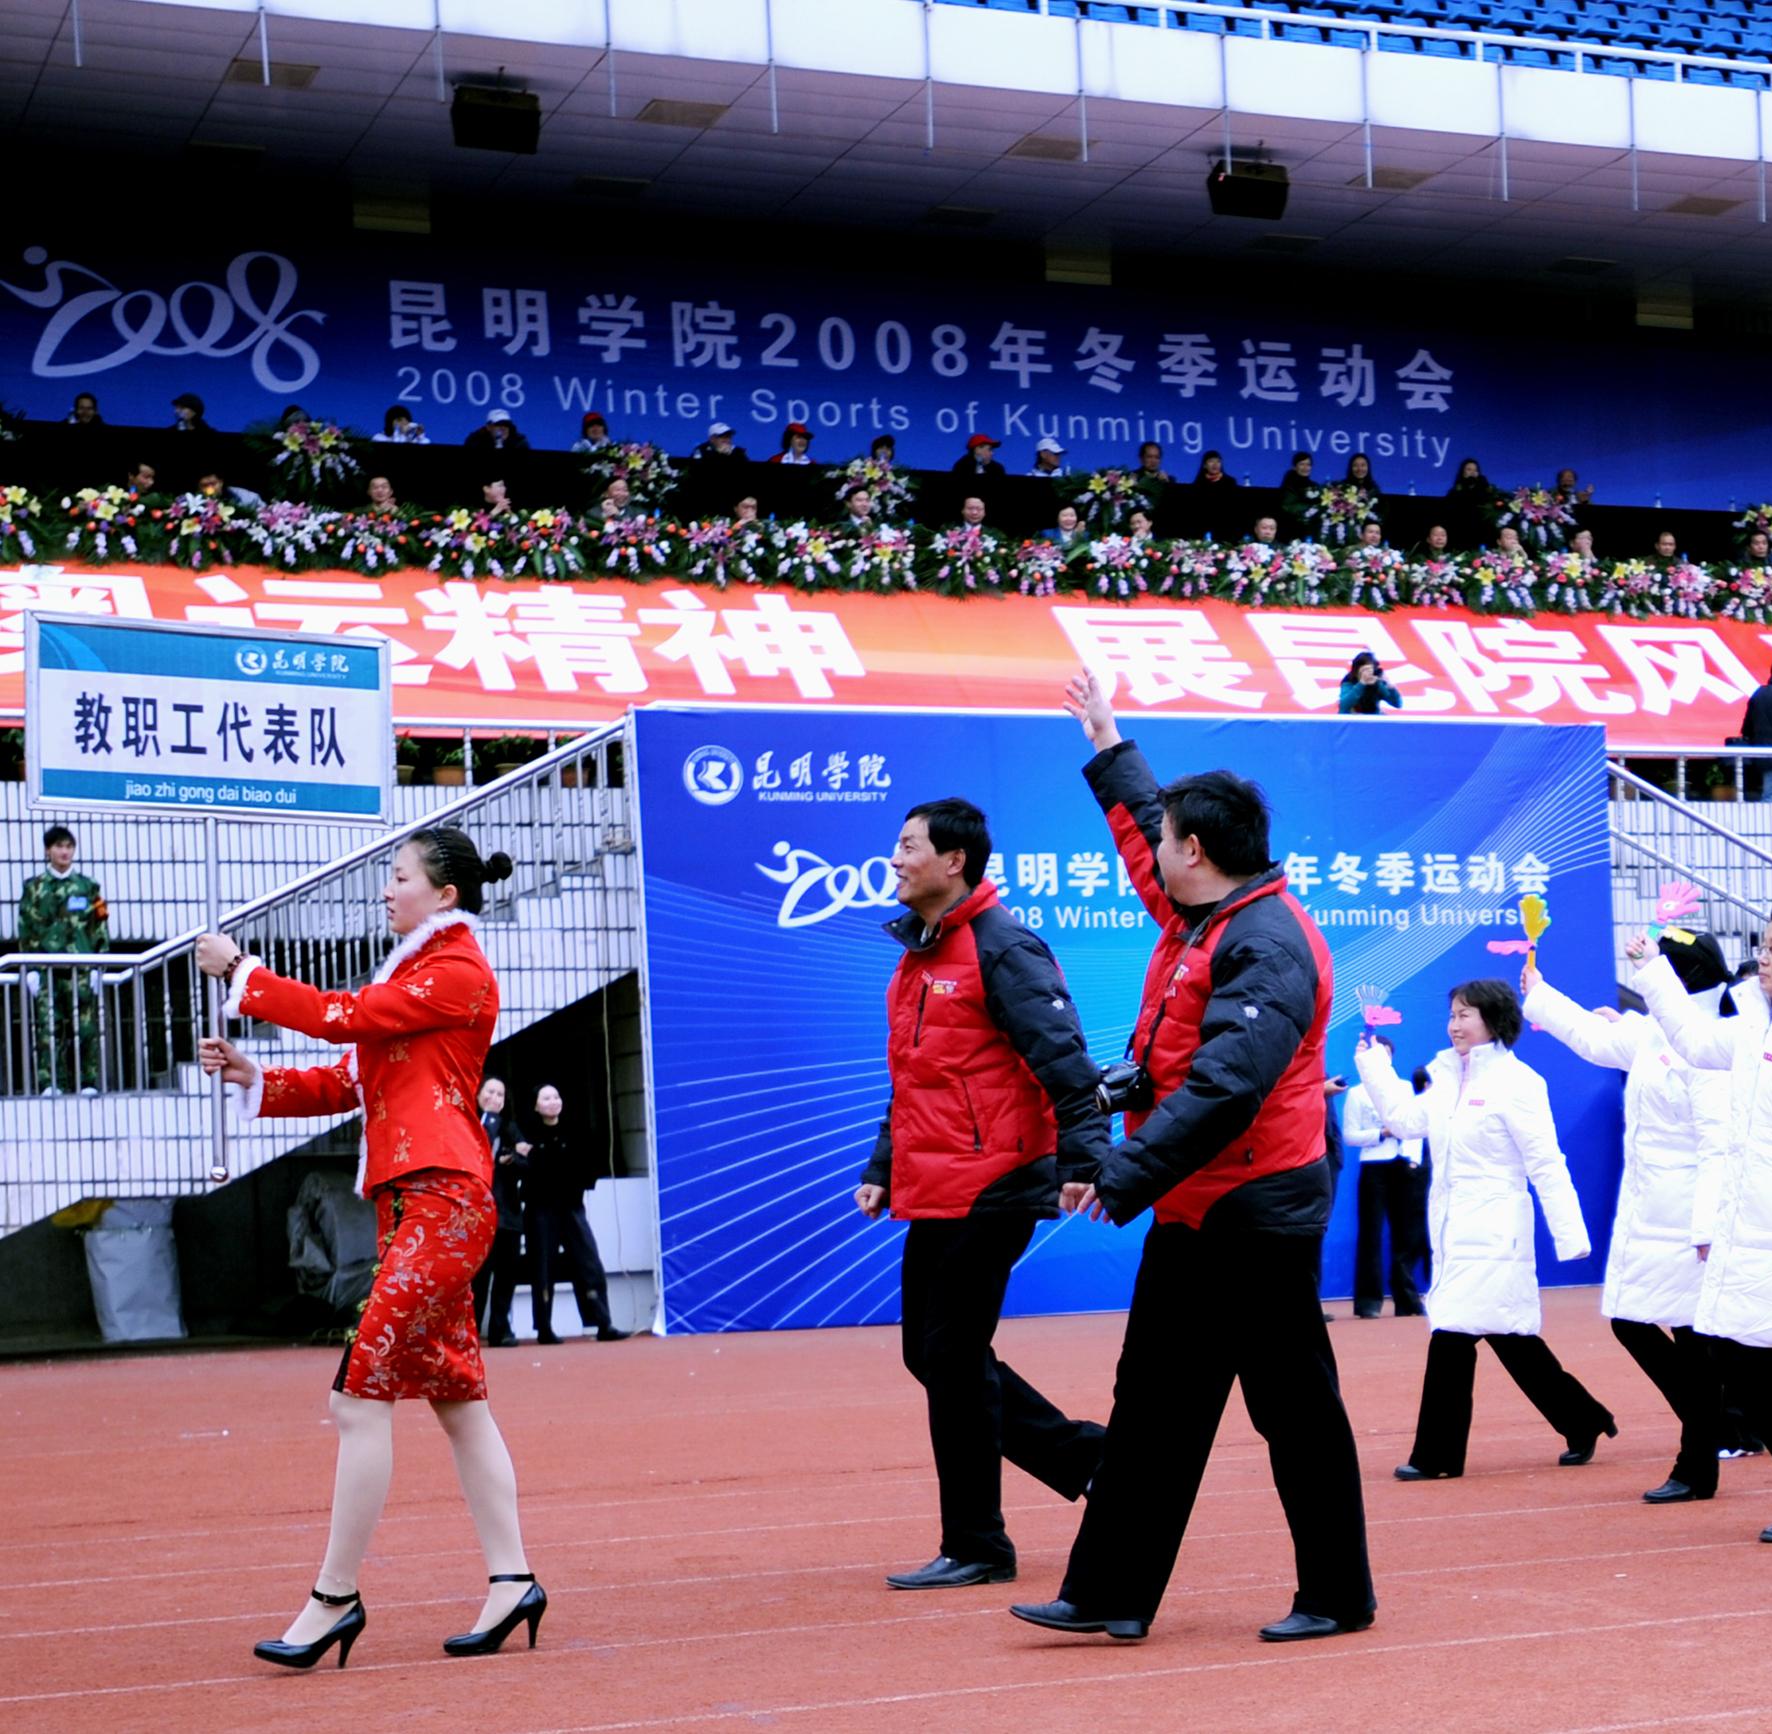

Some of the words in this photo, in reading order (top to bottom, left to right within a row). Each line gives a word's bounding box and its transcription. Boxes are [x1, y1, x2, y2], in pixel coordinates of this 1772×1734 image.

[389, 280, 1454, 413] 昆明学院2008年冬季运动会
[396, 366, 526, 408] 2008
[553, 375, 724, 420] Winter
[751, 388, 911, 431] Sports
[936, 401, 979, 433] of
[1003, 402, 1203, 454] Kunming
[1228, 416, 1451, 468] University
[74, 691, 346, 768] 教职工代表队
[125, 780, 151, 799] jiao
[154, 782, 176, 797] zhi
[178, 786, 214, 803] gong
[217, 785, 239, 801] dai
[242, 786, 272, 803] biao
[275, 788, 297, 804] dui
[758, 791, 814, 802] KUNMING
[815, 791, 888, 802] UNIVERSITY
[1283, 851, 1551, 896] 年冬季运动会
[1055, 906, 1148, 928] Winter
[1420, 904, 1548, 926] Universi
